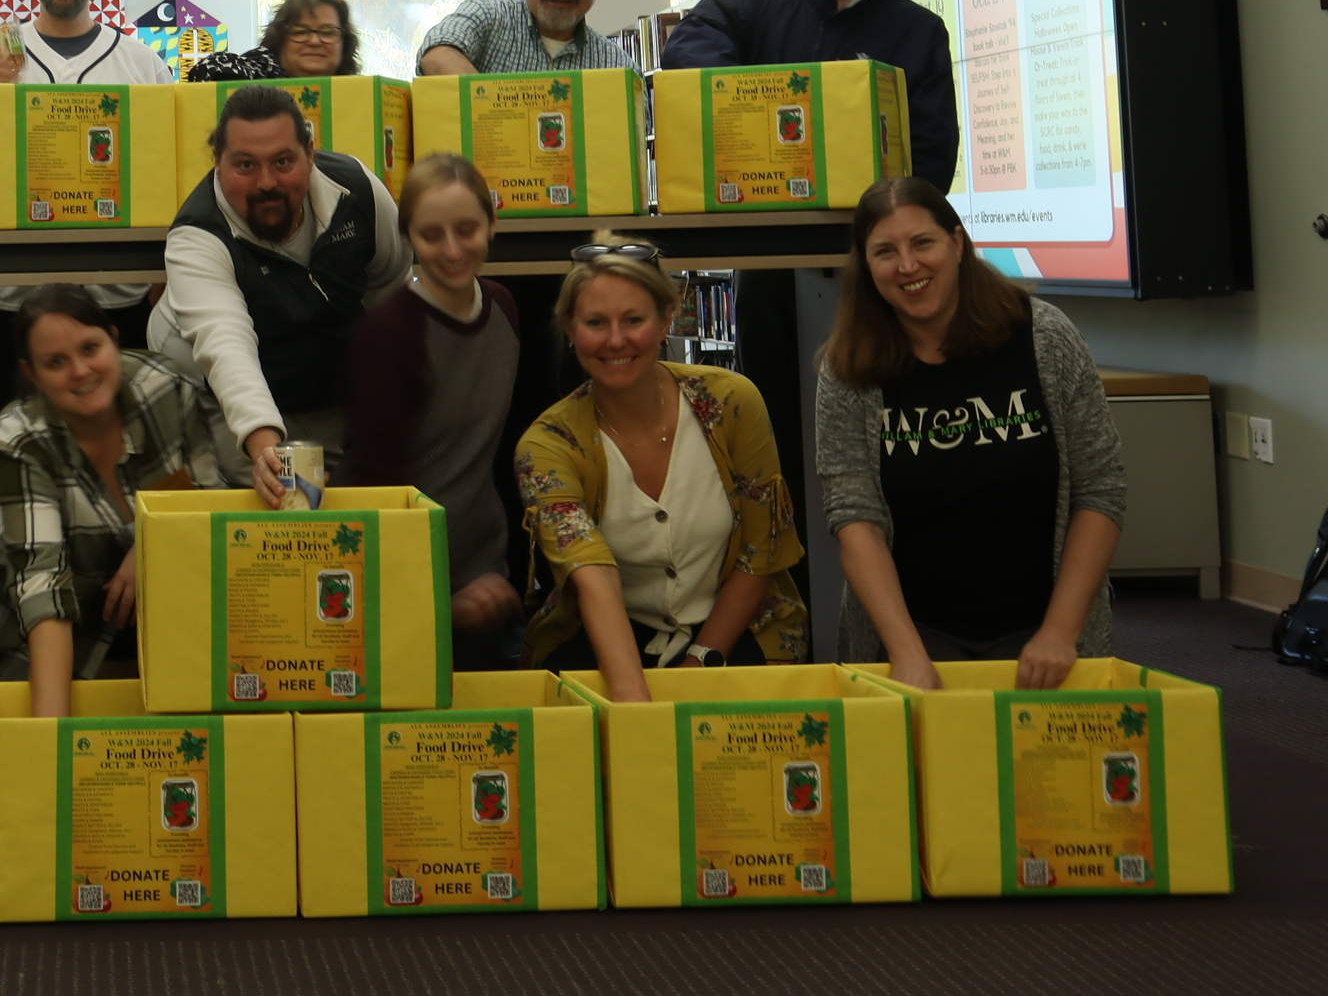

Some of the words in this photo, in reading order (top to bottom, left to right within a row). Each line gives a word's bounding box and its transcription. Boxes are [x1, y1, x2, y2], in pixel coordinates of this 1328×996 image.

[1051, 4, 1080, 19] Collections
[1034, 25, 1062, 39] Halloween
[1063, 22, 1078, 34] Open
[497, 92, 519, 101] Food
[522, 91, 547, 100] Drive
[736, 86, 758, 95] Food
[761, 85, 786, 93] Drive
[51, 105, 72, 113] Food
[74, 105, 97, 114] Drive
[502, 178, 546, 187] DONATE
[742, 172, 786, 181] DONATE
[53, 191, 94, 200] DONATE
[752, 186, 780, 194] HERE
[511, 193, 540, 201] HERE
[62, 205, 88, 214] HERE
[332, 229, 356, 242] MARY
[882, 388, 1041, 456] W&M
[940, 422, 972, 436] MARY
[978, 410, 1041, 429] LIBRARIES
[262, 540, 293, 552] Food
[297, 540, 330, 552] Drive
[266, 659, 325, 672] DONATE
[278, 679, 316, 691] HERE
[728, 732, 758, 744] Food
[762, 732, 796, 744] Drive
[416, 741, 447, 753] Food
[451, 741, 485, 753] Drive
[106, 748, 136, 760] Food
[141, 748, 175, 760] Drive
[735, 854, 795, 866] DONATE
[421, 862, 482, 875] DONATE
[110, 870, 170, 882] DONATE
[748, 874, 786, 886] HERE
[435, 883, 473, 894] HERE
[123, 890, 161, 901] HERE
